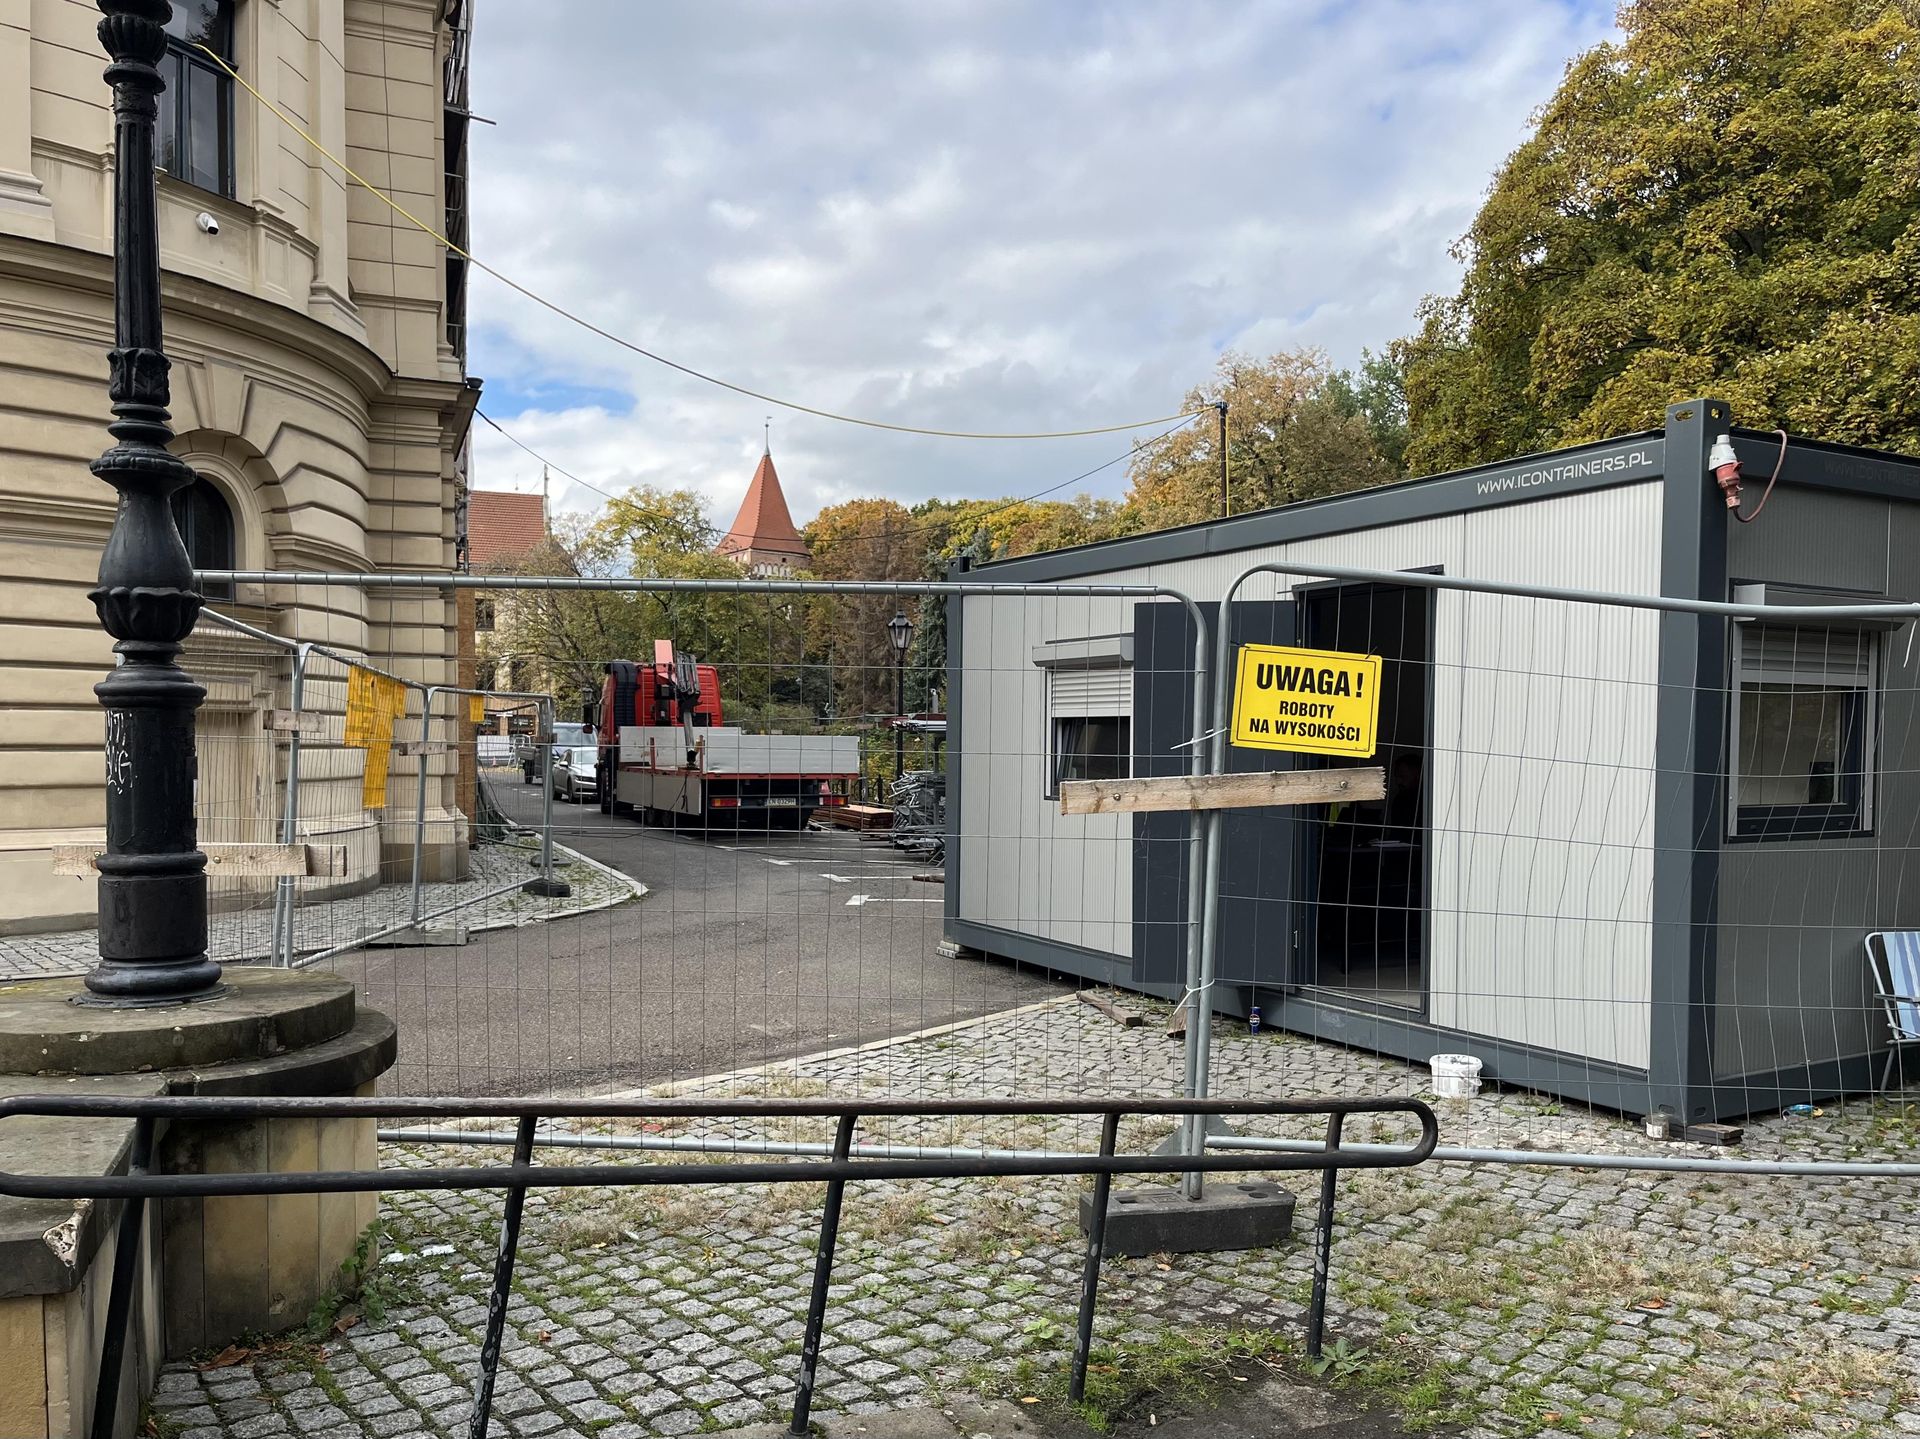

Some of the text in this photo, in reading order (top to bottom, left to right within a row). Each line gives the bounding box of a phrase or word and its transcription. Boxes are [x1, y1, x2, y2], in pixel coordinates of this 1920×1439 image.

[1477, 452, 1652, 495] WWW.ICONTAINERS.PL
[1279, 700, 1334, 719] ROBOTY
[1249, 718, 1361, 742] NA WYSOKOŚCI
